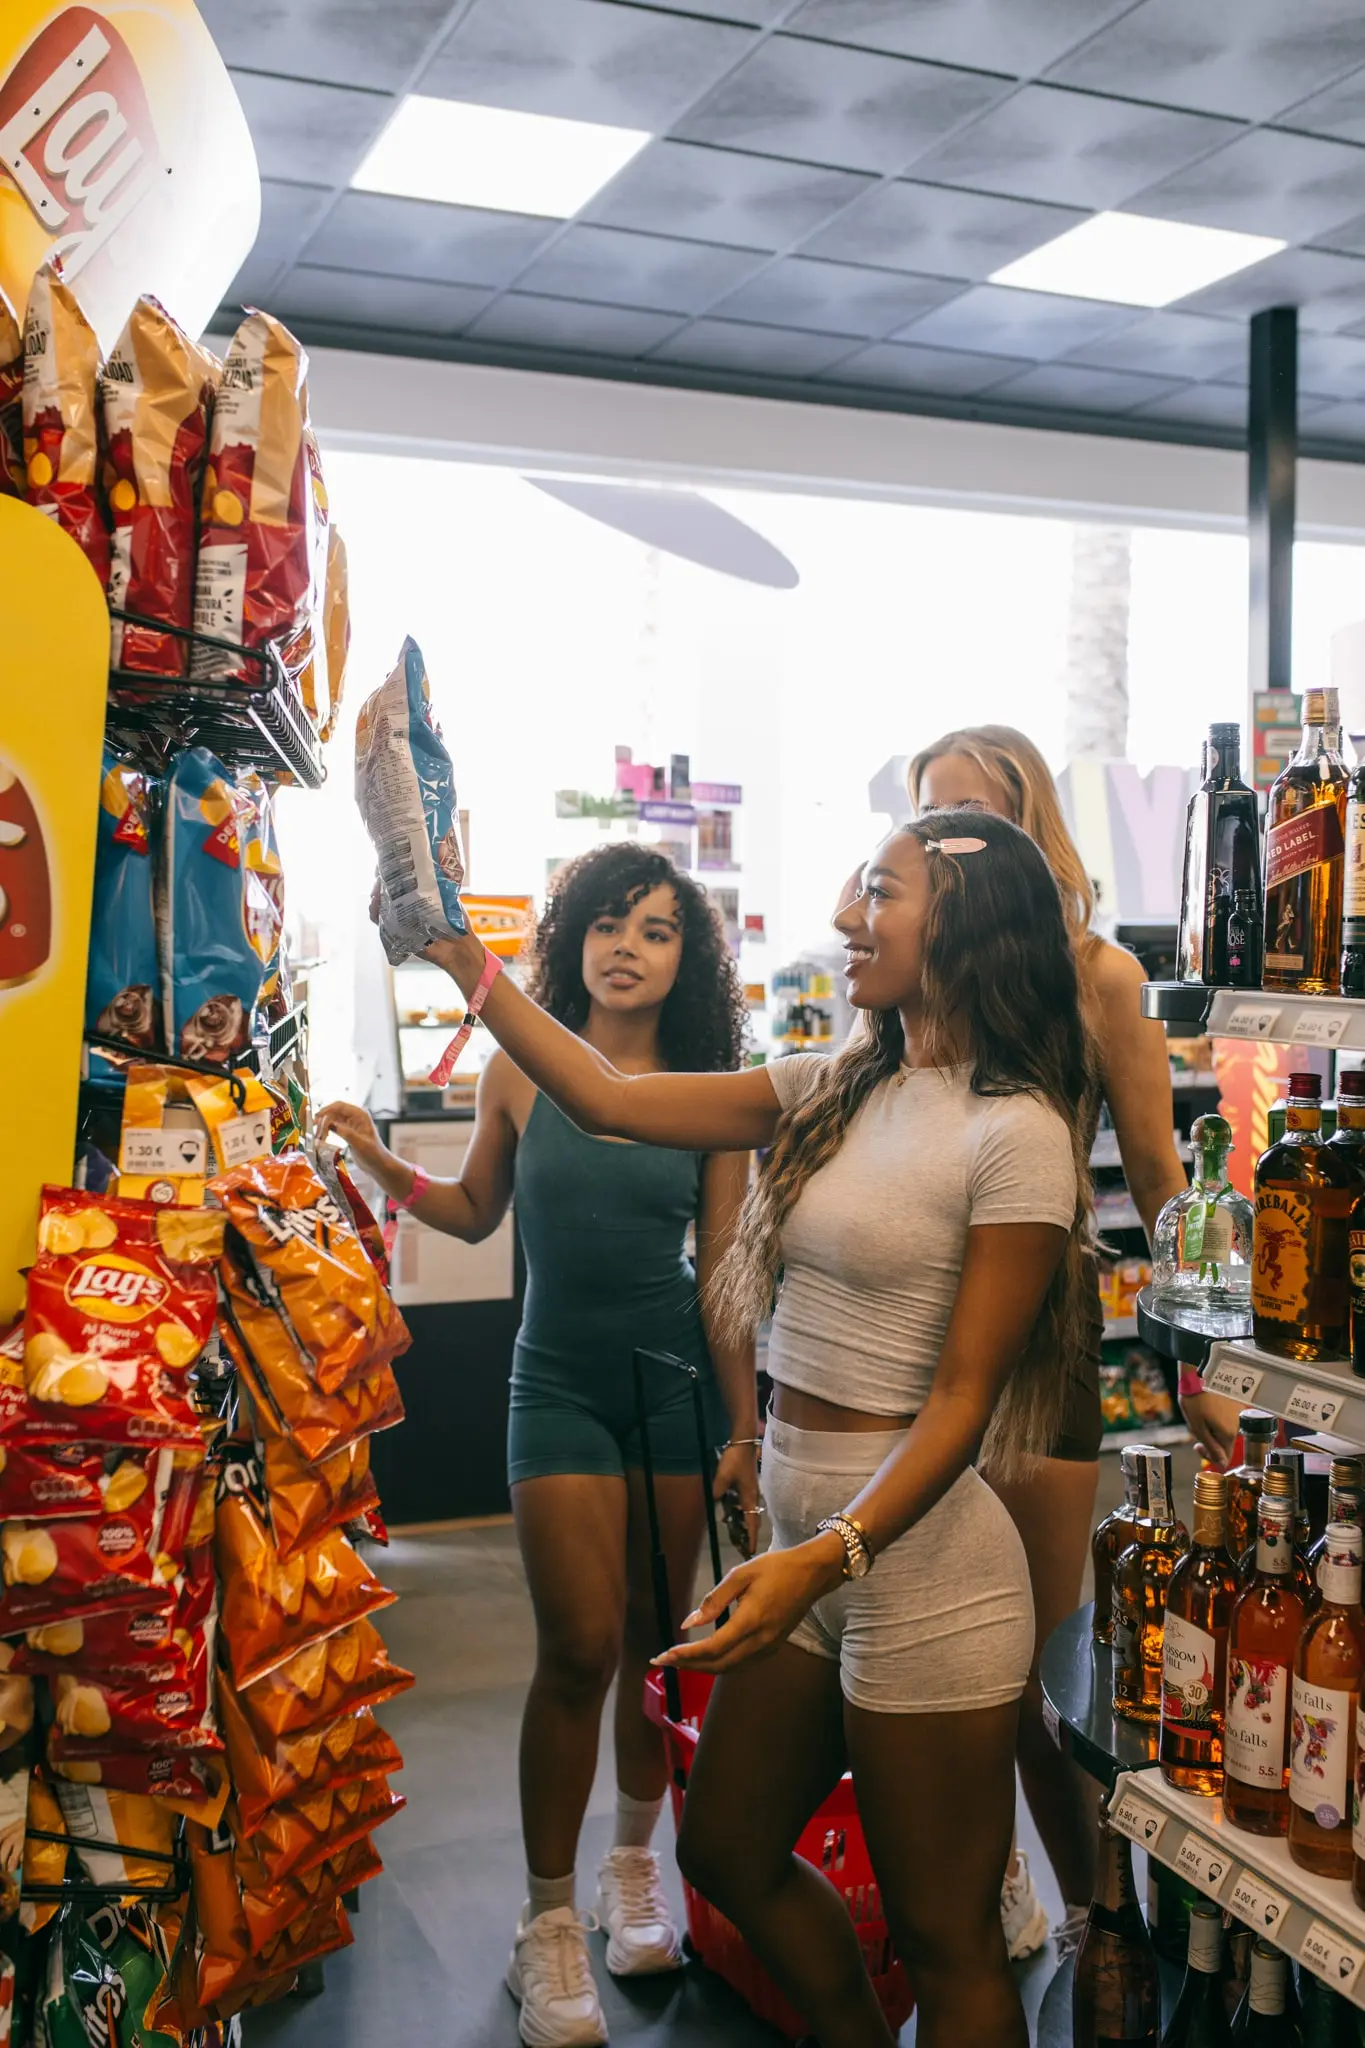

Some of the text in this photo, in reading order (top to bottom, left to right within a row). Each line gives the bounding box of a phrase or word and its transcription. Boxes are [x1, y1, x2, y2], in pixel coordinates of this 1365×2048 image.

[0, 23, 147, 286] Lay
[1284, 831, 1316, 851] LABEL
[127, 1145, 163, 1157] 1.30 €
[1311, 1402, 1318, 1412] €
[1164, 1645, 1196, 1665] OSSOM
[1118, 1684, 1128, 1698] 12
[1187, 1684, 1202, 1700] 30
[1304, 1691, 1333, 1712] falls
[1240, 1729, 1269, 1749] falls
[1118, 1807, 1133, 1821] 9.90
[1132, 1816, 1139, 1825] €
[1180, 1847, 1196, 1863] 9.00
[1195, 1857, 1202, 1867] €
[1234, 1888, 1251, 1904] 9.00
[1250, 1899, 1258, 1909] €
[1305, 1938, 1324, 1955] 9.00
[1323, 1950, 1331, 1961] €
